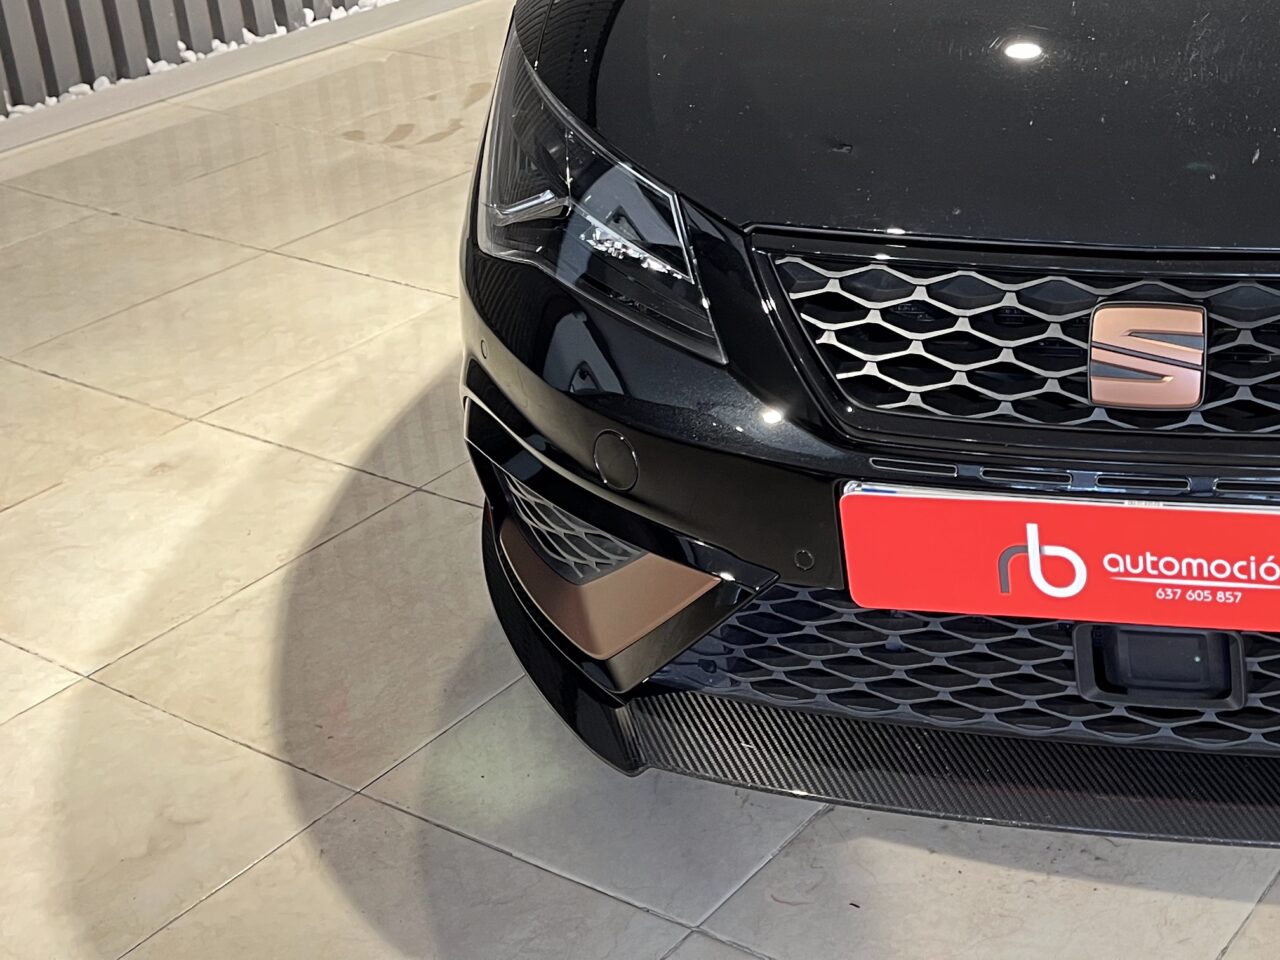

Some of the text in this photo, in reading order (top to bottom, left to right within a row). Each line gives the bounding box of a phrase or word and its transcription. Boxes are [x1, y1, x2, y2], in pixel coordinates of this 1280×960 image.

[998, 523, 1088, 598] rb
[1155, 587, 1242, 603] 637 605 857
